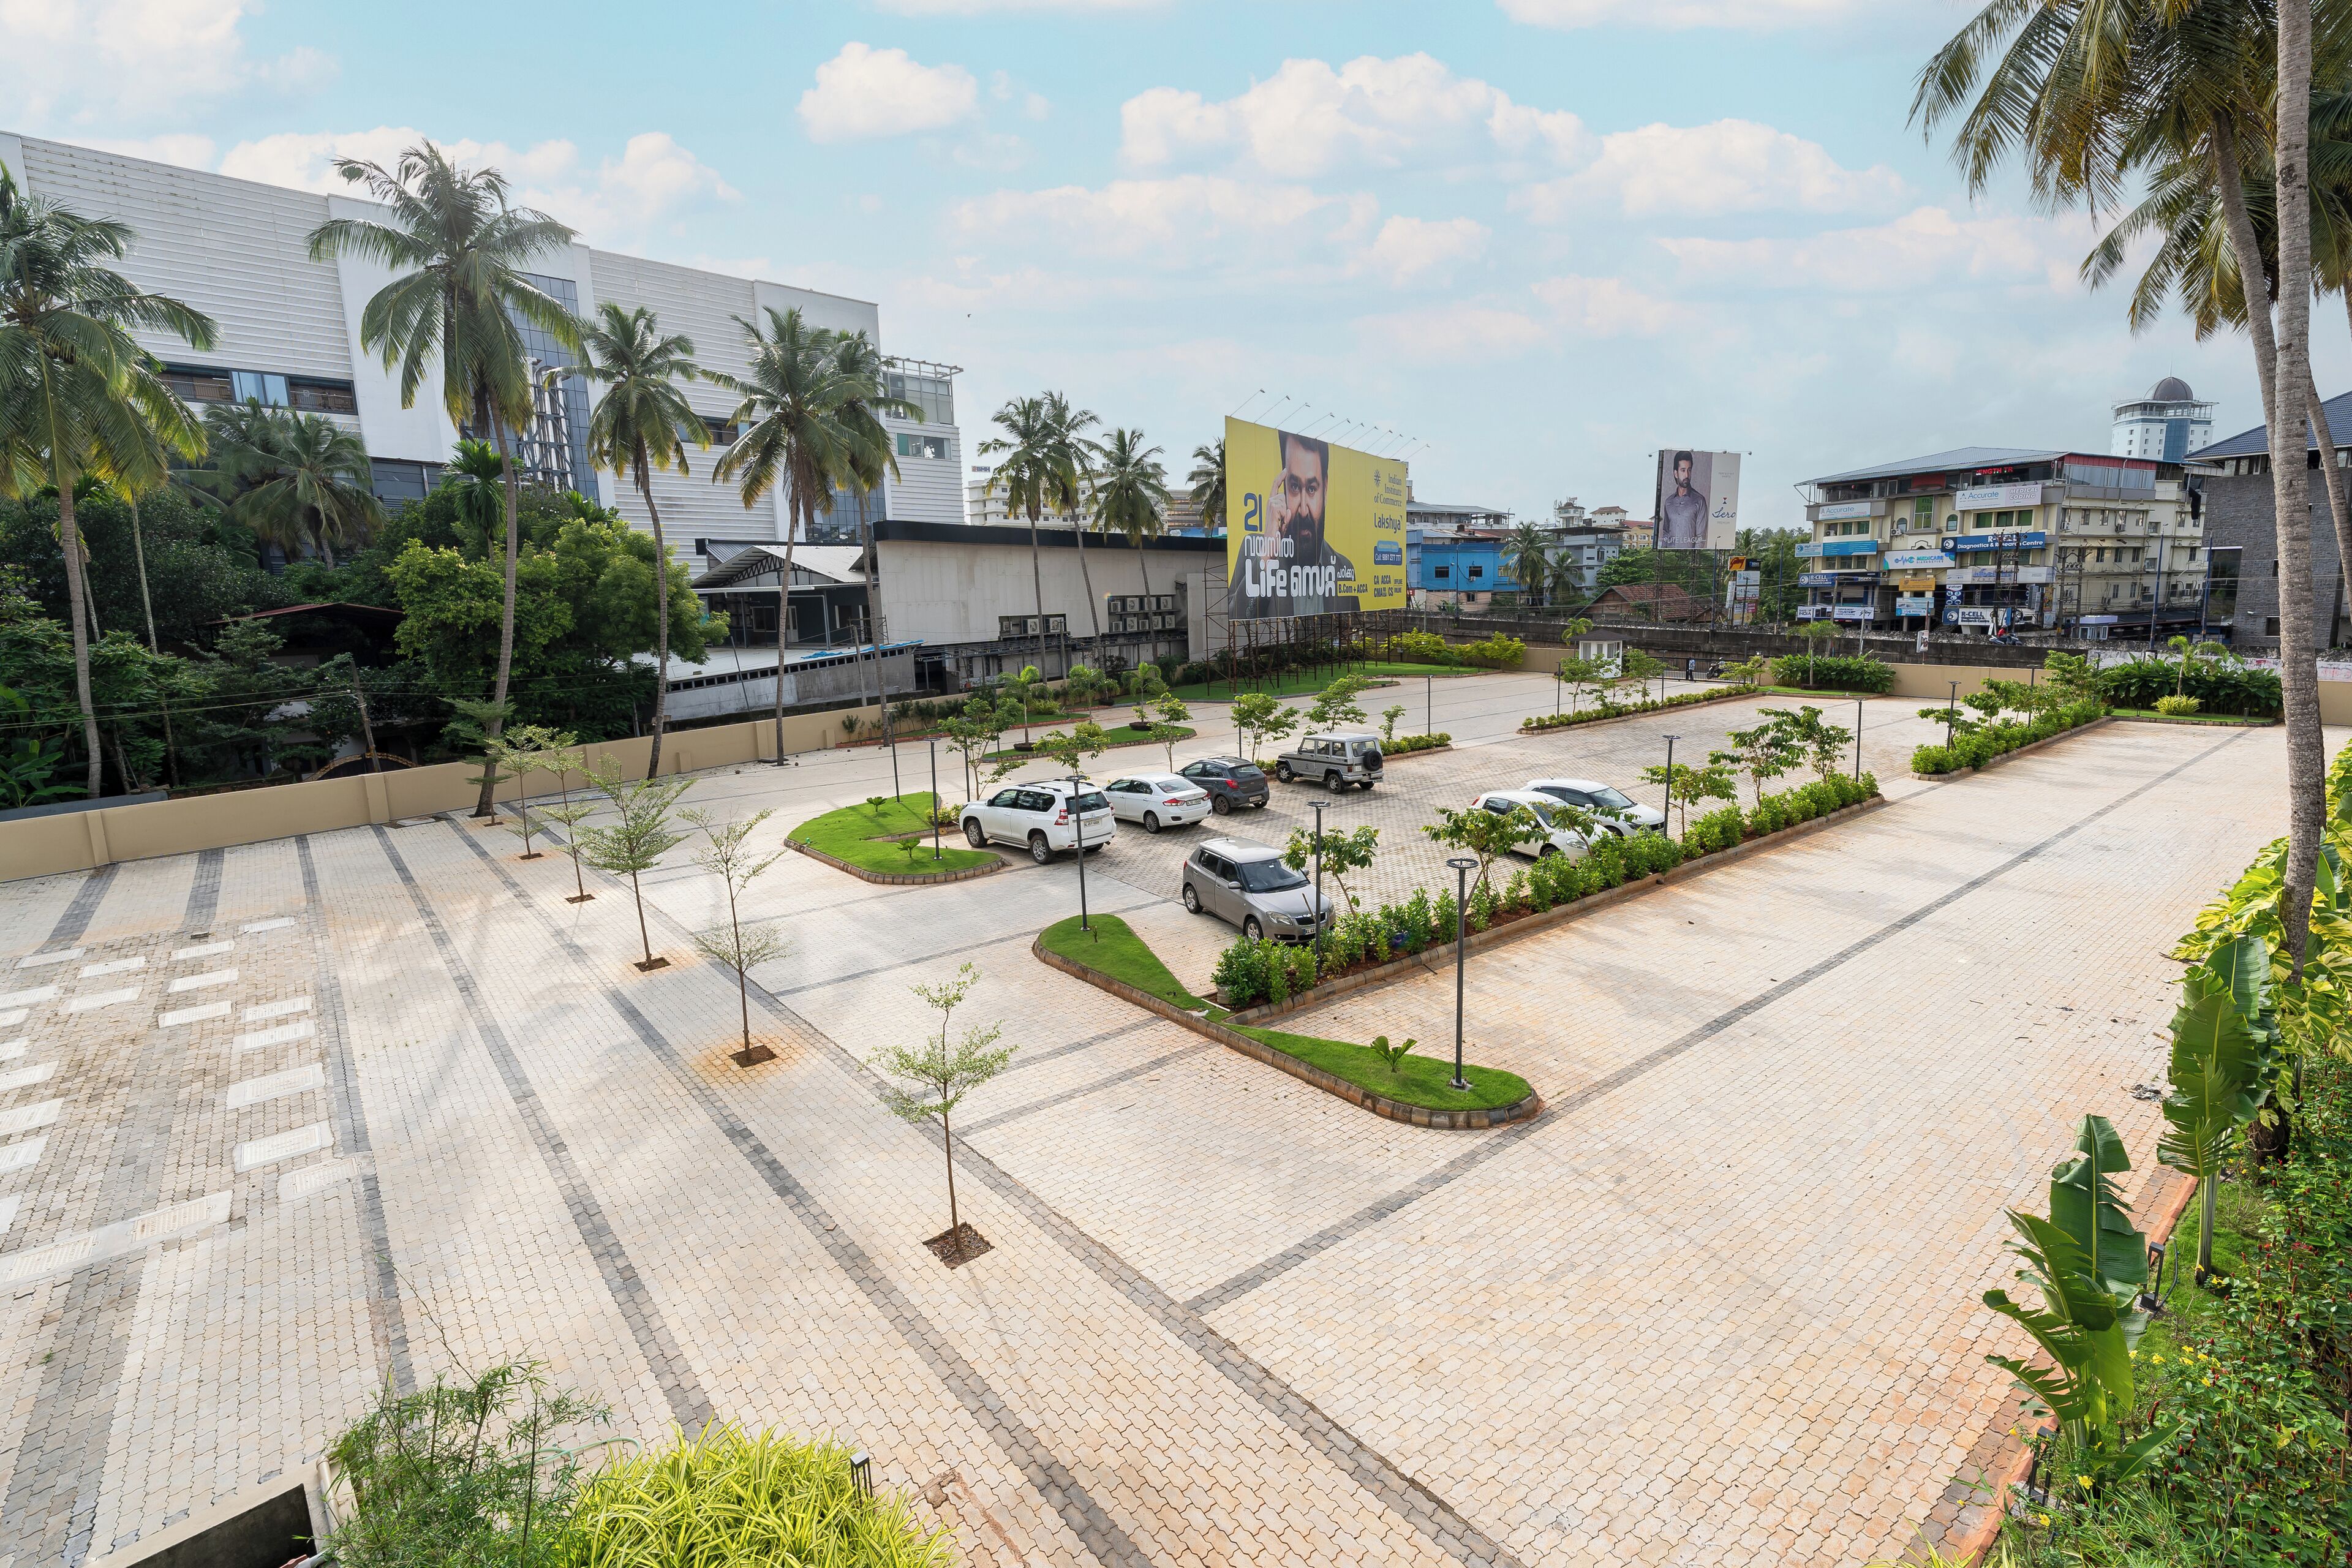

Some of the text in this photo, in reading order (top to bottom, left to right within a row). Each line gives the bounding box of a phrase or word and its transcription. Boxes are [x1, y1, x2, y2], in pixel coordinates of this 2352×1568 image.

[1388, 473, 1402, 486] Indian
[1384, 483, 1402, 497] Institute
[1374, 492, 1402, 507] of Commerce
[1244, 492, 1263, 532] 21
[1374, 575, 1391, 585] CA ACCA
[1357, 584, 1368, 594] ACCA
[1374, 587, 1382, 598] CMA
[1389, 587, 1393, 597] CS
